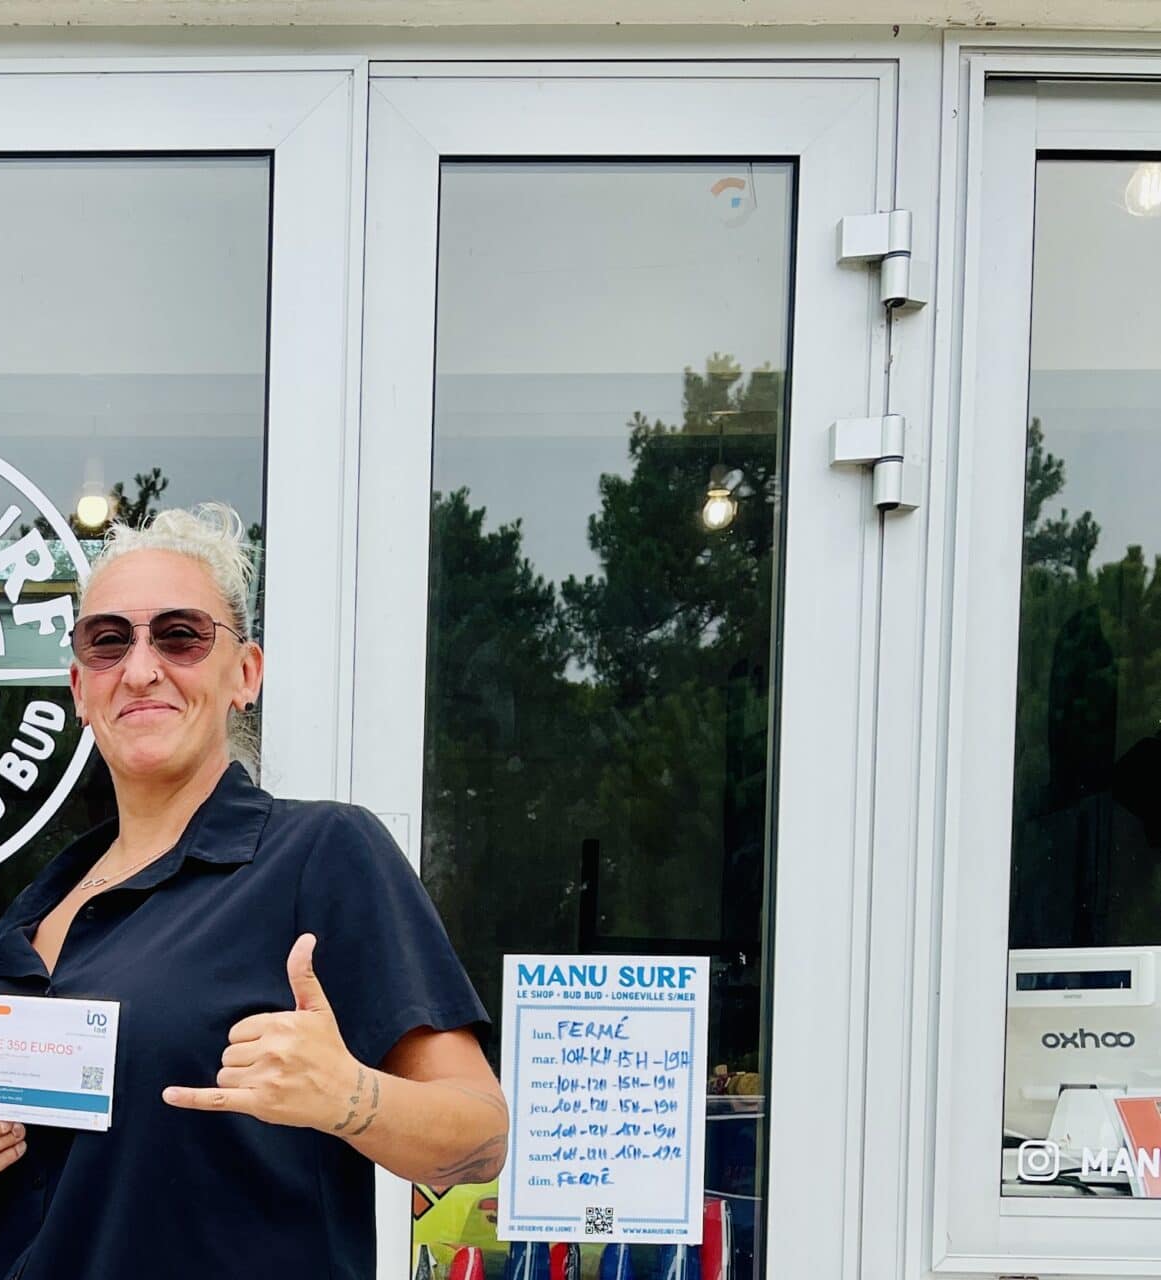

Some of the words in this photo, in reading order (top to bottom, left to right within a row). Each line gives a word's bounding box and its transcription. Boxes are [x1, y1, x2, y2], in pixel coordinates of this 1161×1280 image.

[517, 964, 608, 987] MANU
[618, 965, 697, 989] SURF
[516, 990, 528, 999] LE
[530, 990, 554, 999] SHOP
[563, 991, 582, 1000] BUD
[584, 991, 603, 1000] BUD
[611, 991, 665, 1001] LONGEVILLE
[667, 992, 696, 1001] S/MER
[557, 1016, 630, 1041] FERMÉ
[532, 1029, 556, 1041] lun.
[1041, 1028, 1135, 1049] oxhoo
[7, 1040, 27, 1052] 350
[30, 1042, 74, 1056] EUROS
[531, 1055, 558, 1065] mar.
[530, 1080, 556, 1089] mer.
[528, 1176, 554, 1186] dim.
